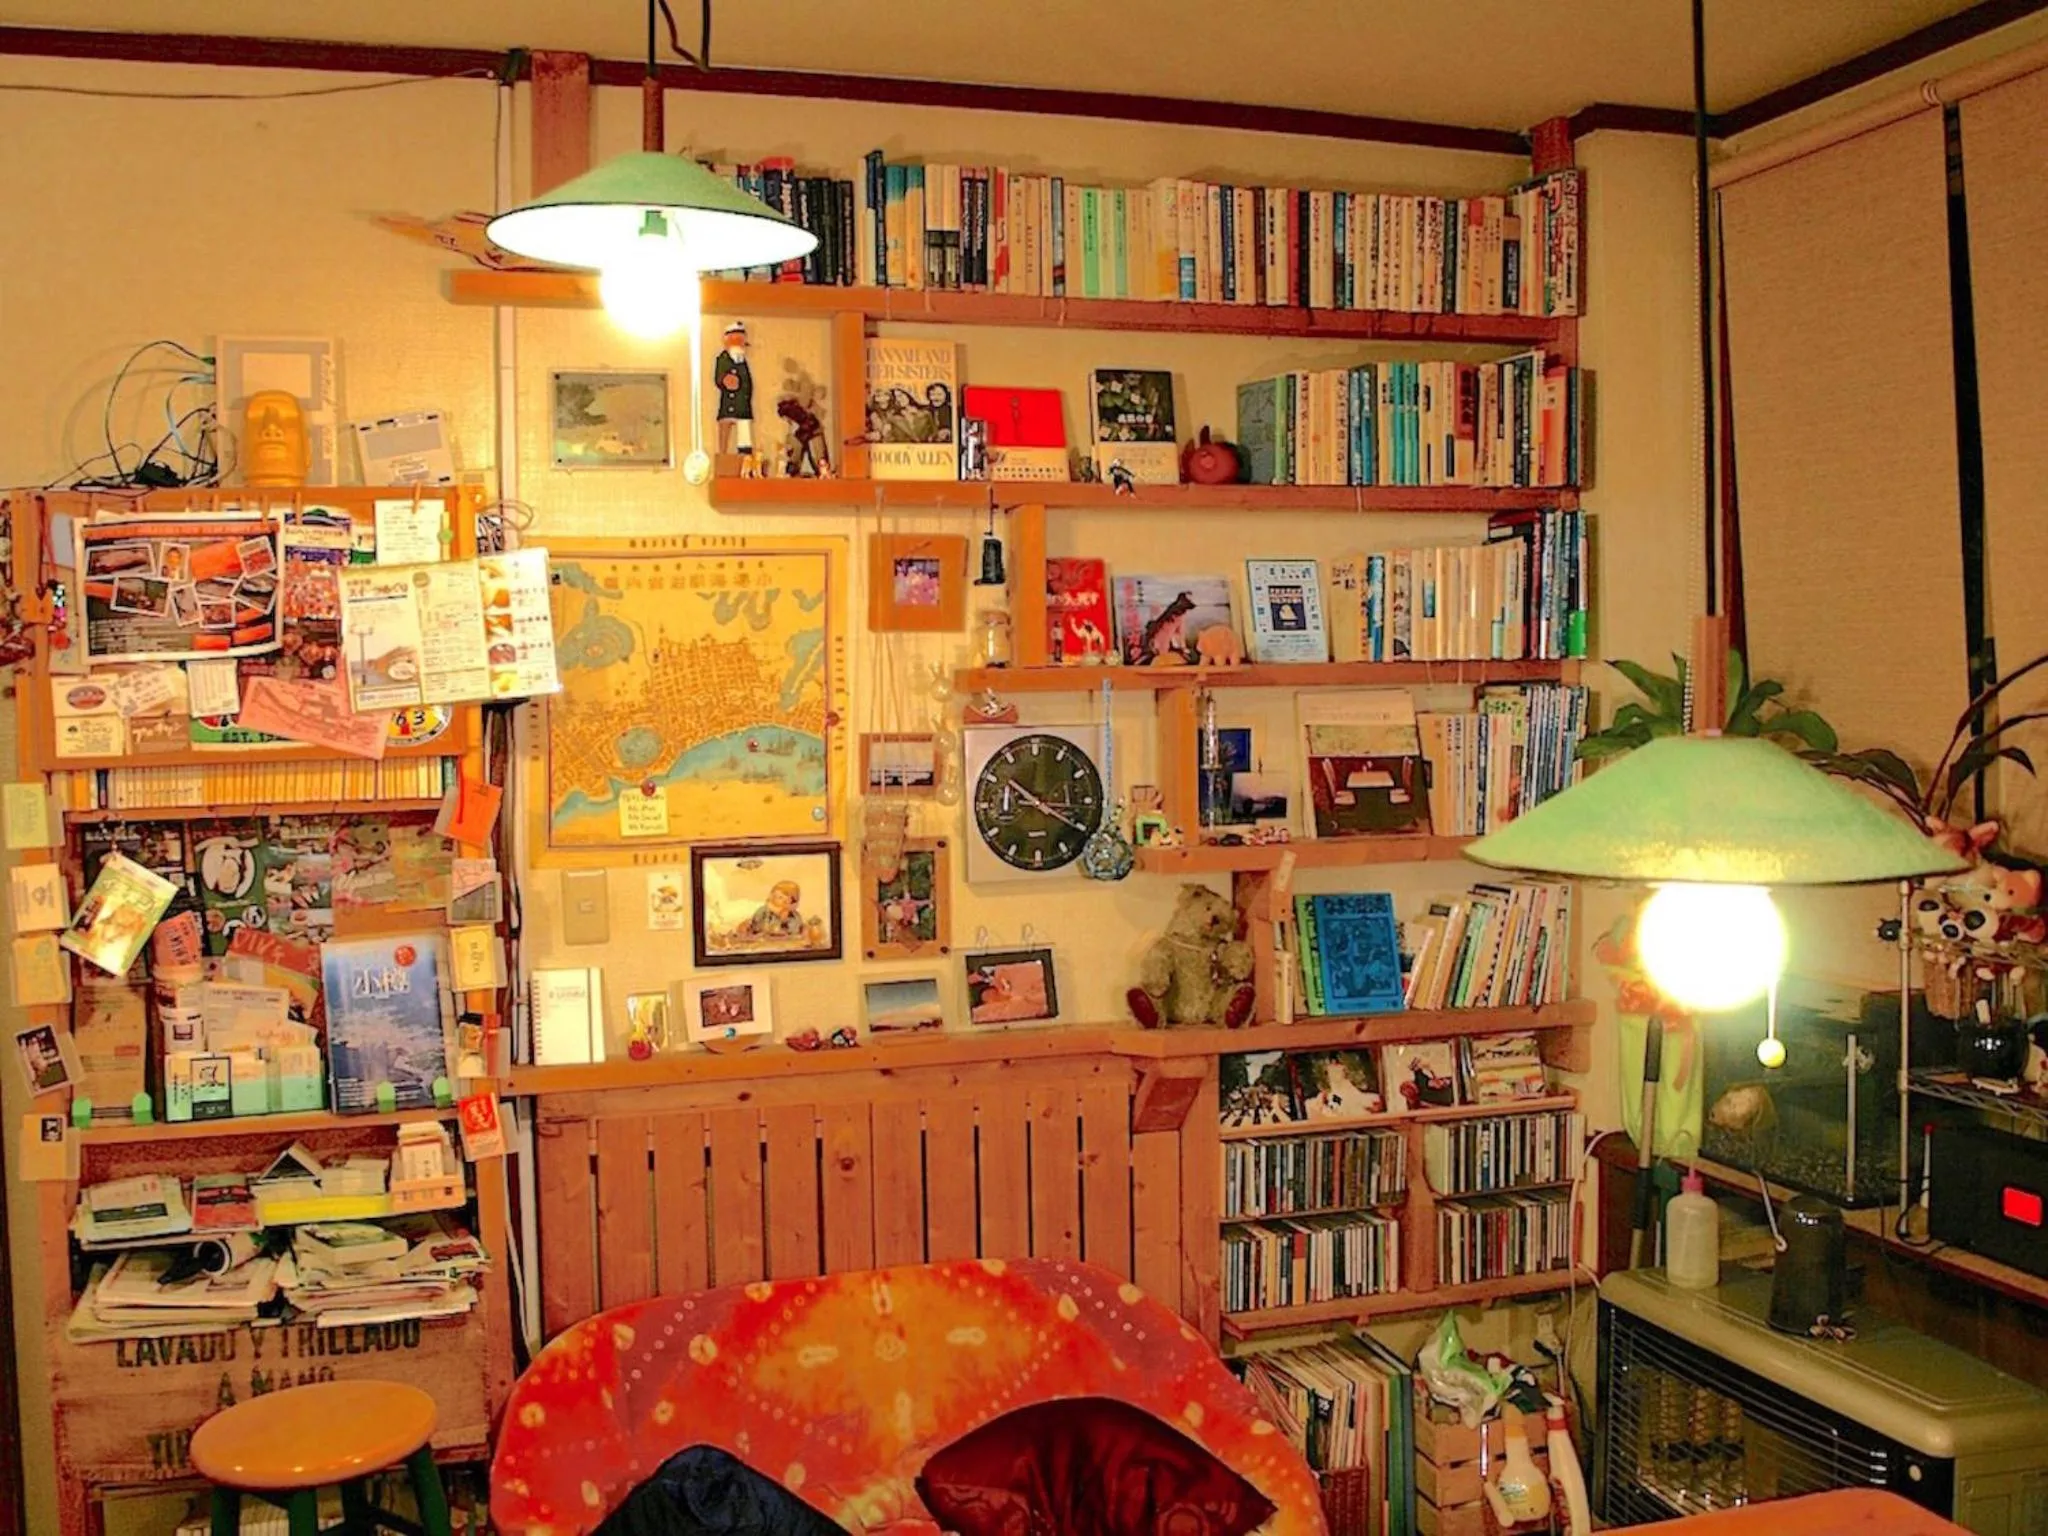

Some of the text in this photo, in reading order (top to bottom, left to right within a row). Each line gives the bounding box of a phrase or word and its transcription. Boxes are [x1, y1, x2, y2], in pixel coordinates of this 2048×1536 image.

[916, 451, 953, 466] ALLEN
[115, 1328, 236, 1369] LAVADO
[249, 1325, 266, 1360] Y
